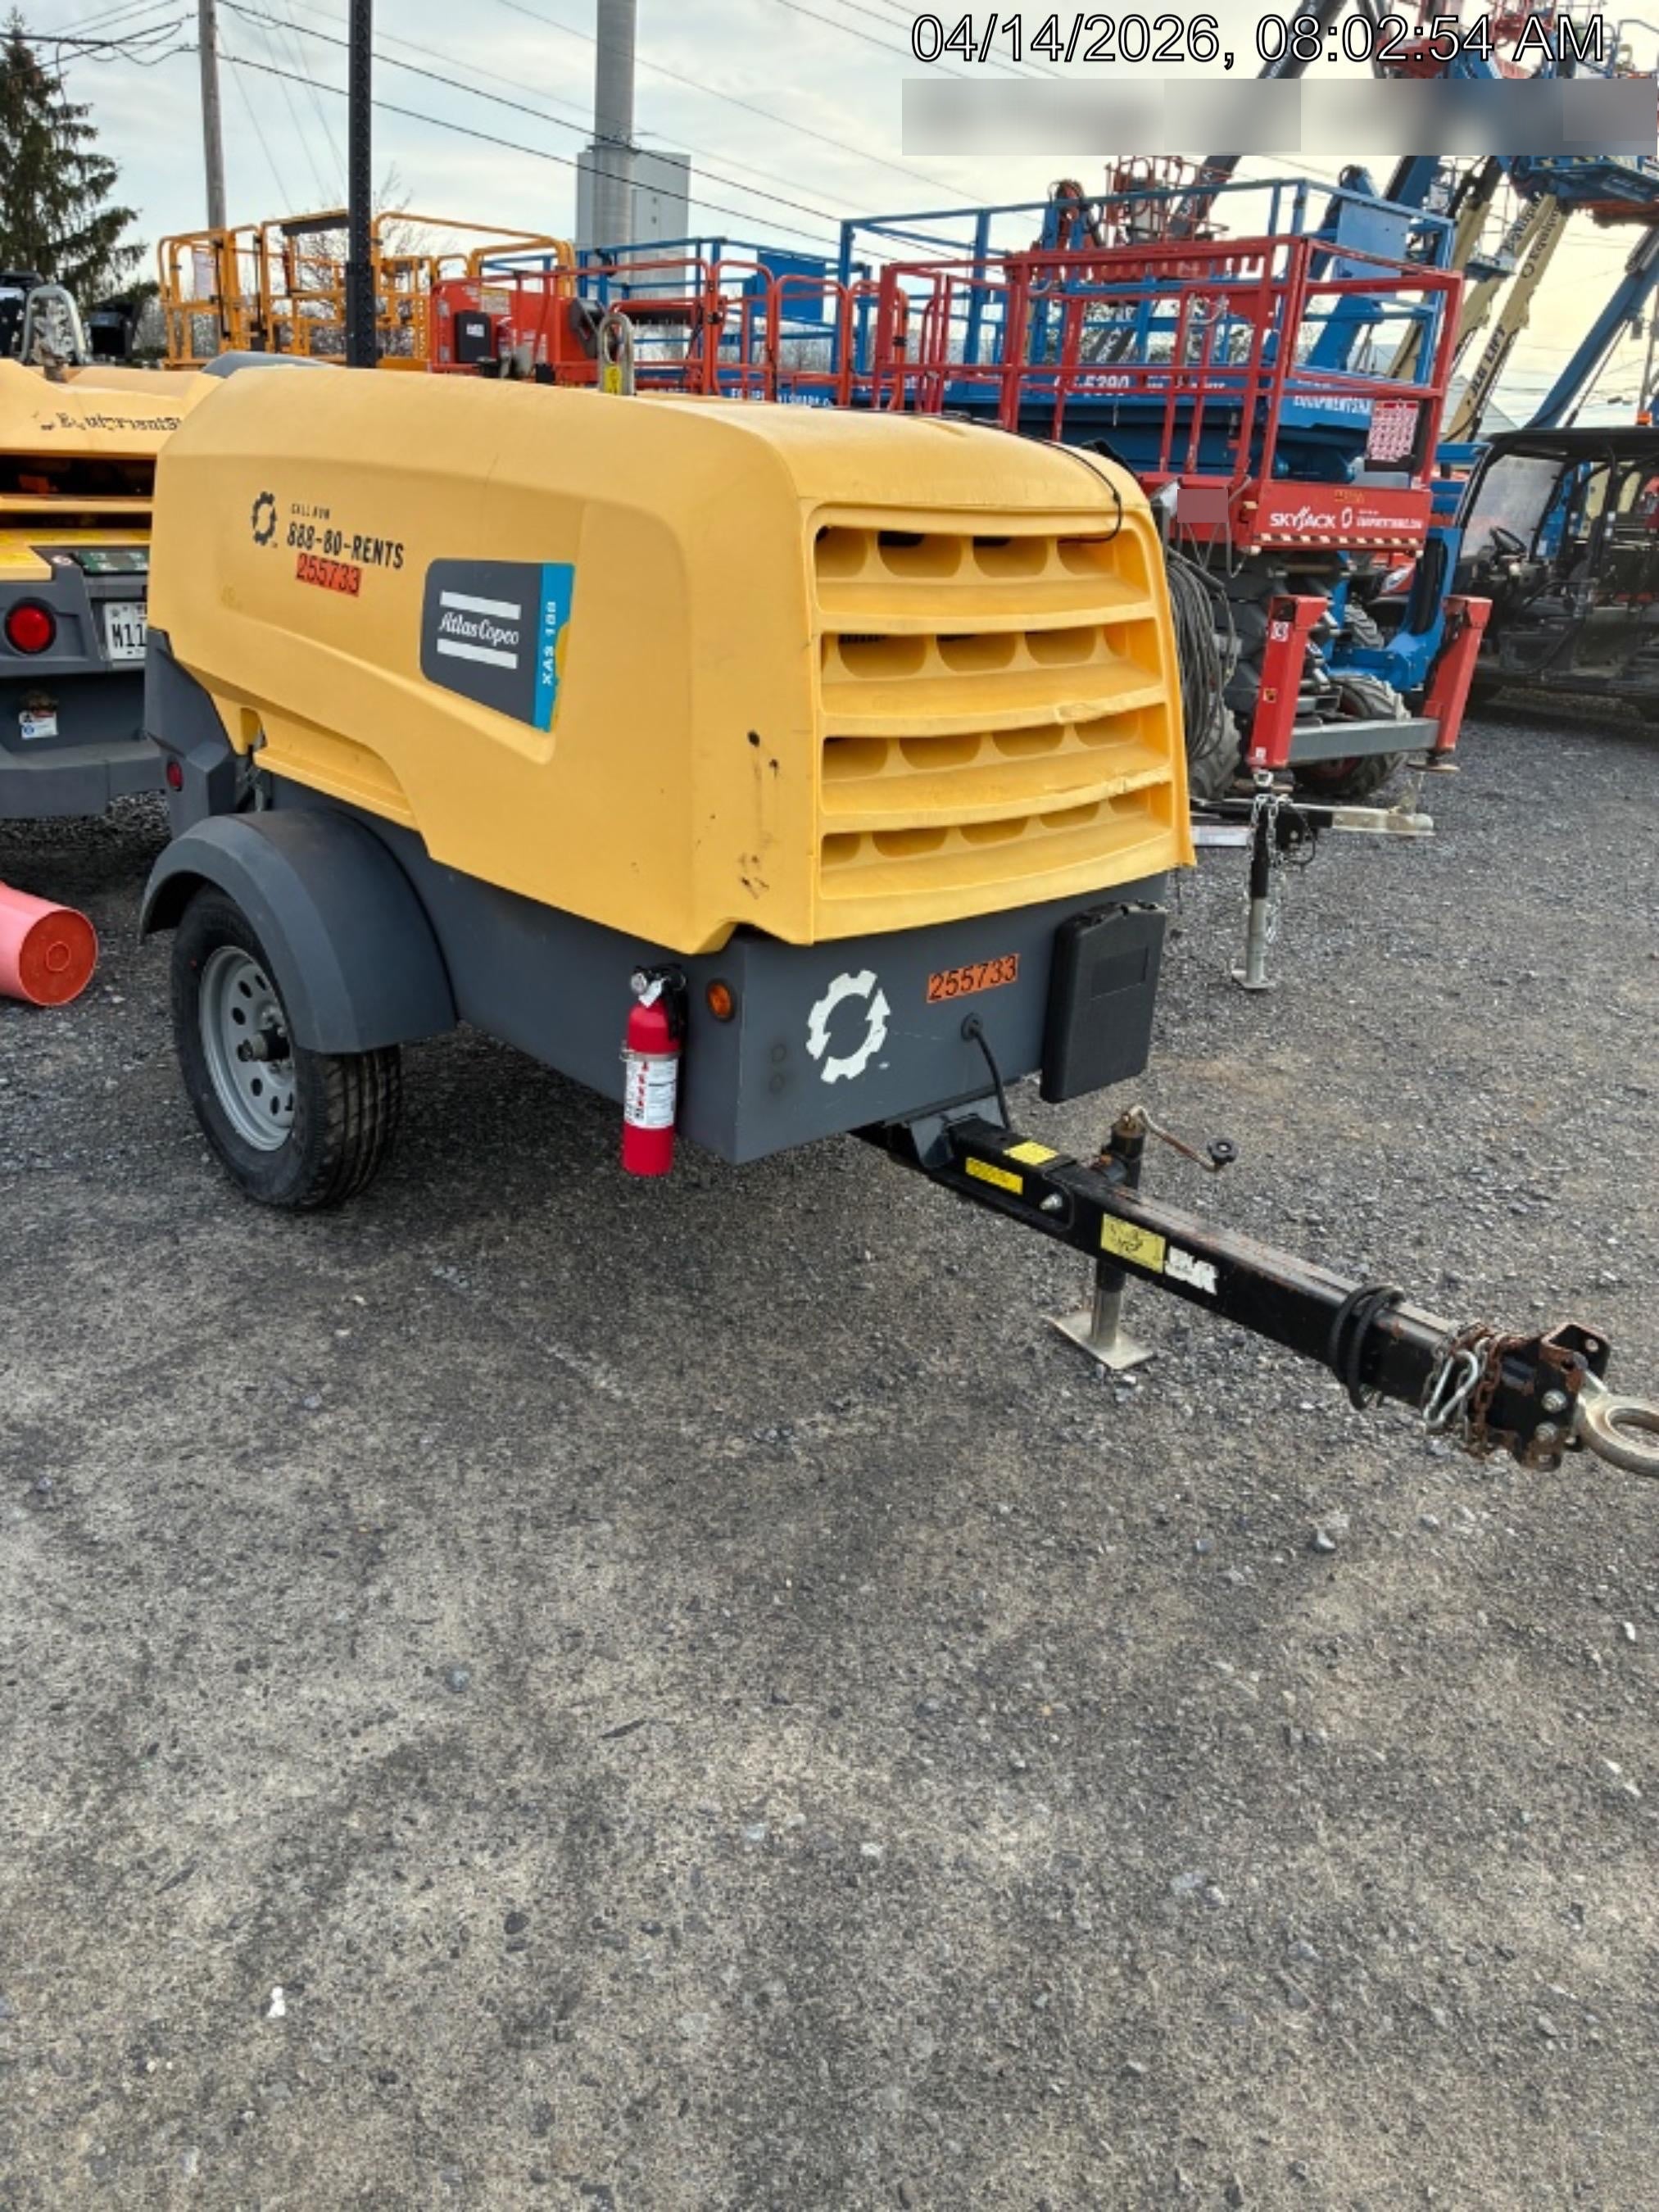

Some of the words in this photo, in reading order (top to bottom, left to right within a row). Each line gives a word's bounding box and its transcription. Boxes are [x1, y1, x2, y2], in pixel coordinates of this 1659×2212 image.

[1483, 325, 1506, 364] LIFT
[1271, 505, 1335, 532] SKYJACK
[287, 521, 405, 569] 888-80-RENTS
[297, 553, 360, 595] 255733
[541, 645, 555, 686] XAS
[928, 954, 1016, 1000] 255733
